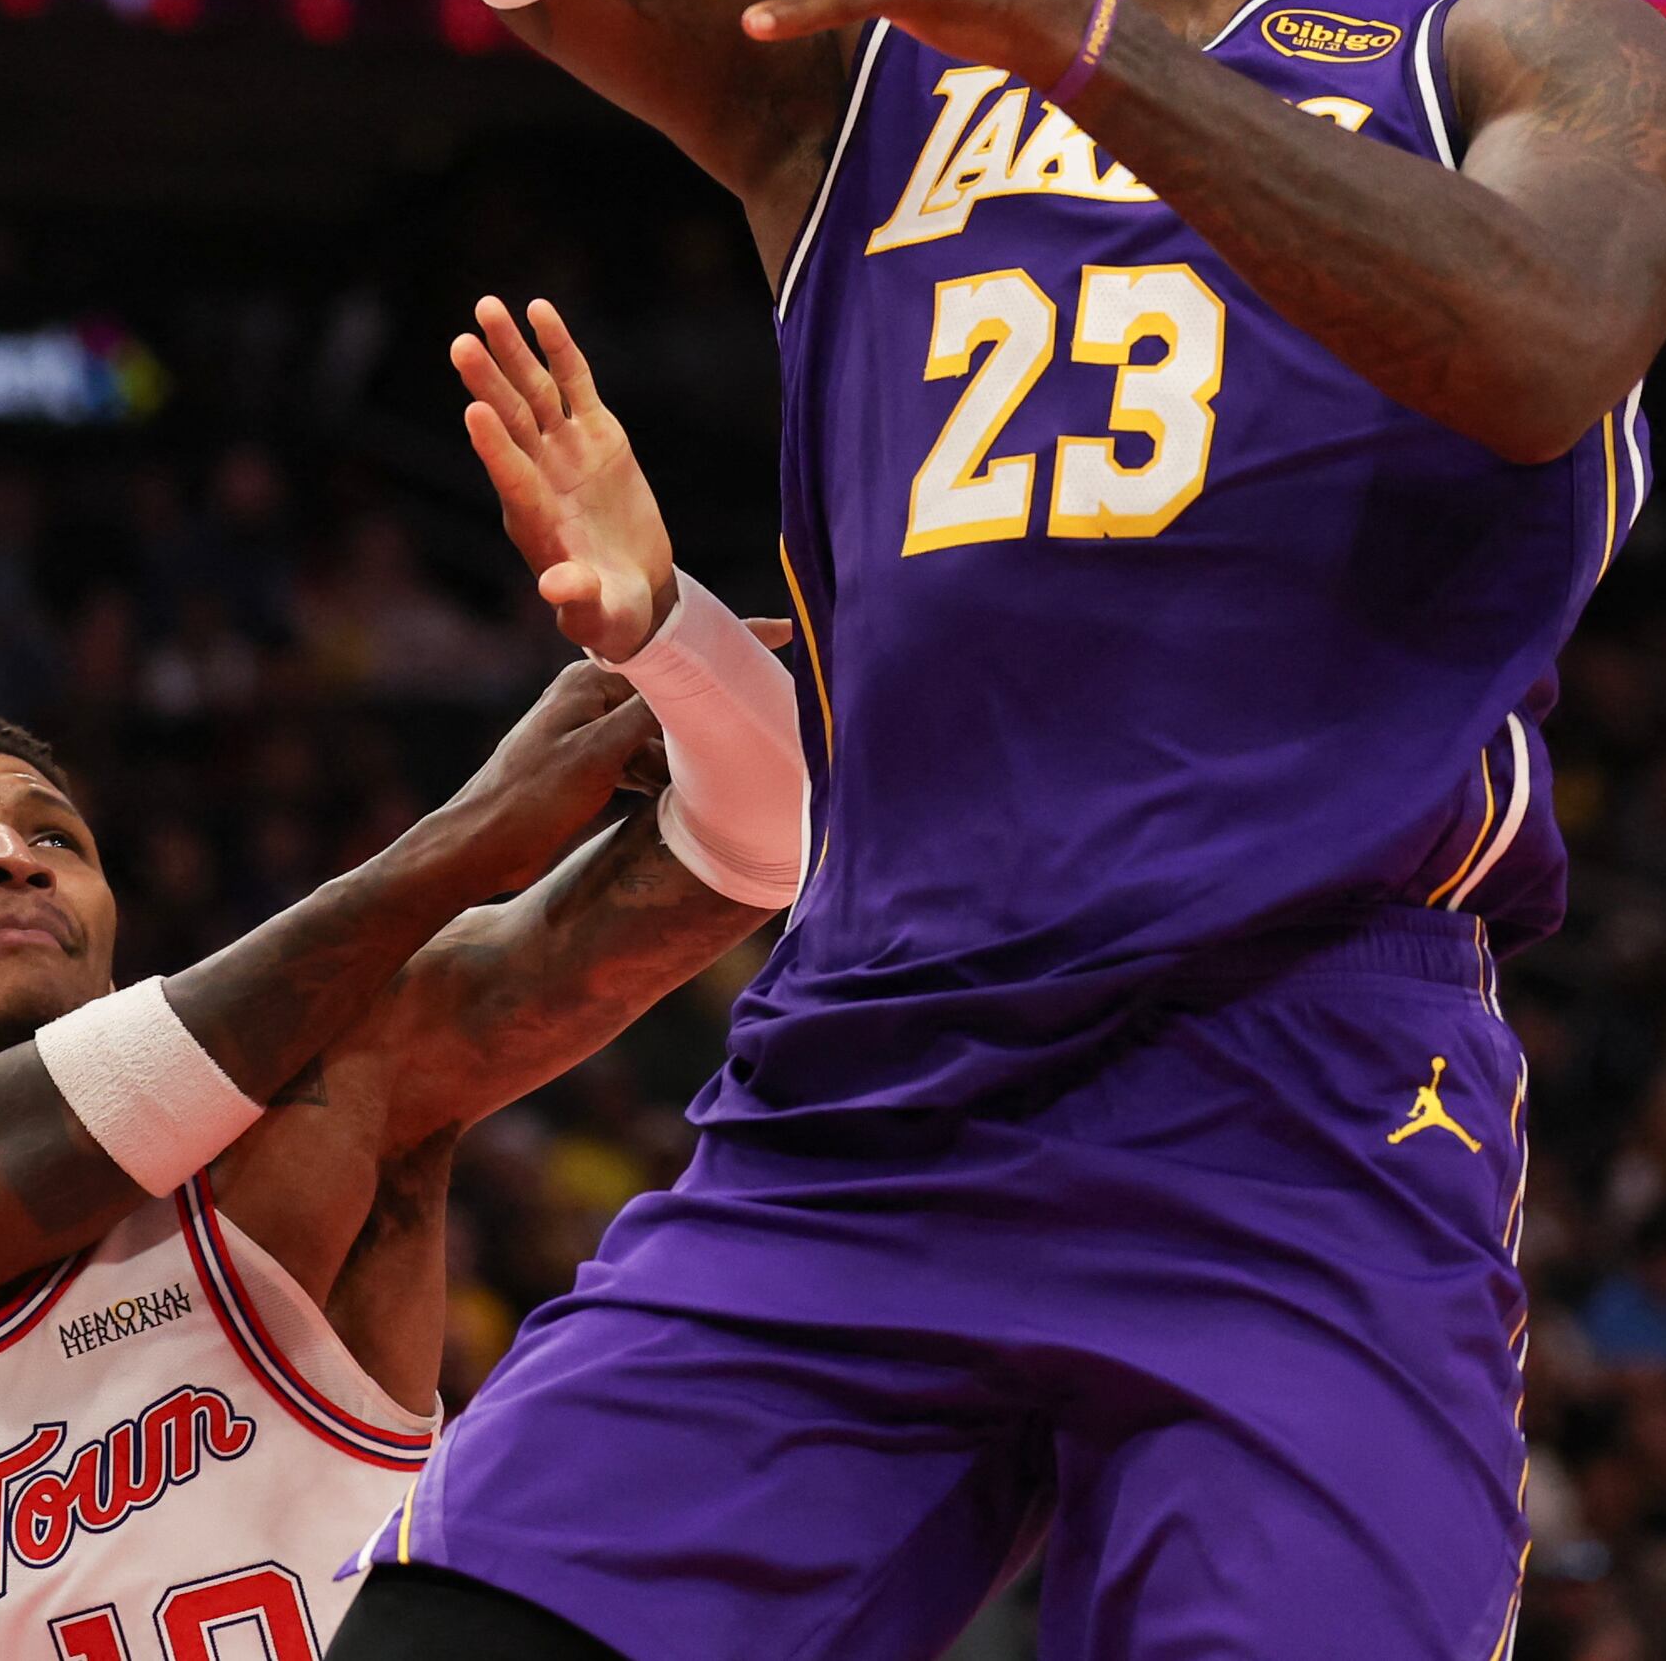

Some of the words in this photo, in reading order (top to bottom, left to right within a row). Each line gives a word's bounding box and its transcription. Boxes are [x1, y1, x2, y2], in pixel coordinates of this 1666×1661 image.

[1275, 16, 1393, 51] bibigo
[902, 263, 1226, 558] 23
[59, 1283, 190, 1344] MEMORIAL
[61, 1297, 192, 1359] HERMANN
